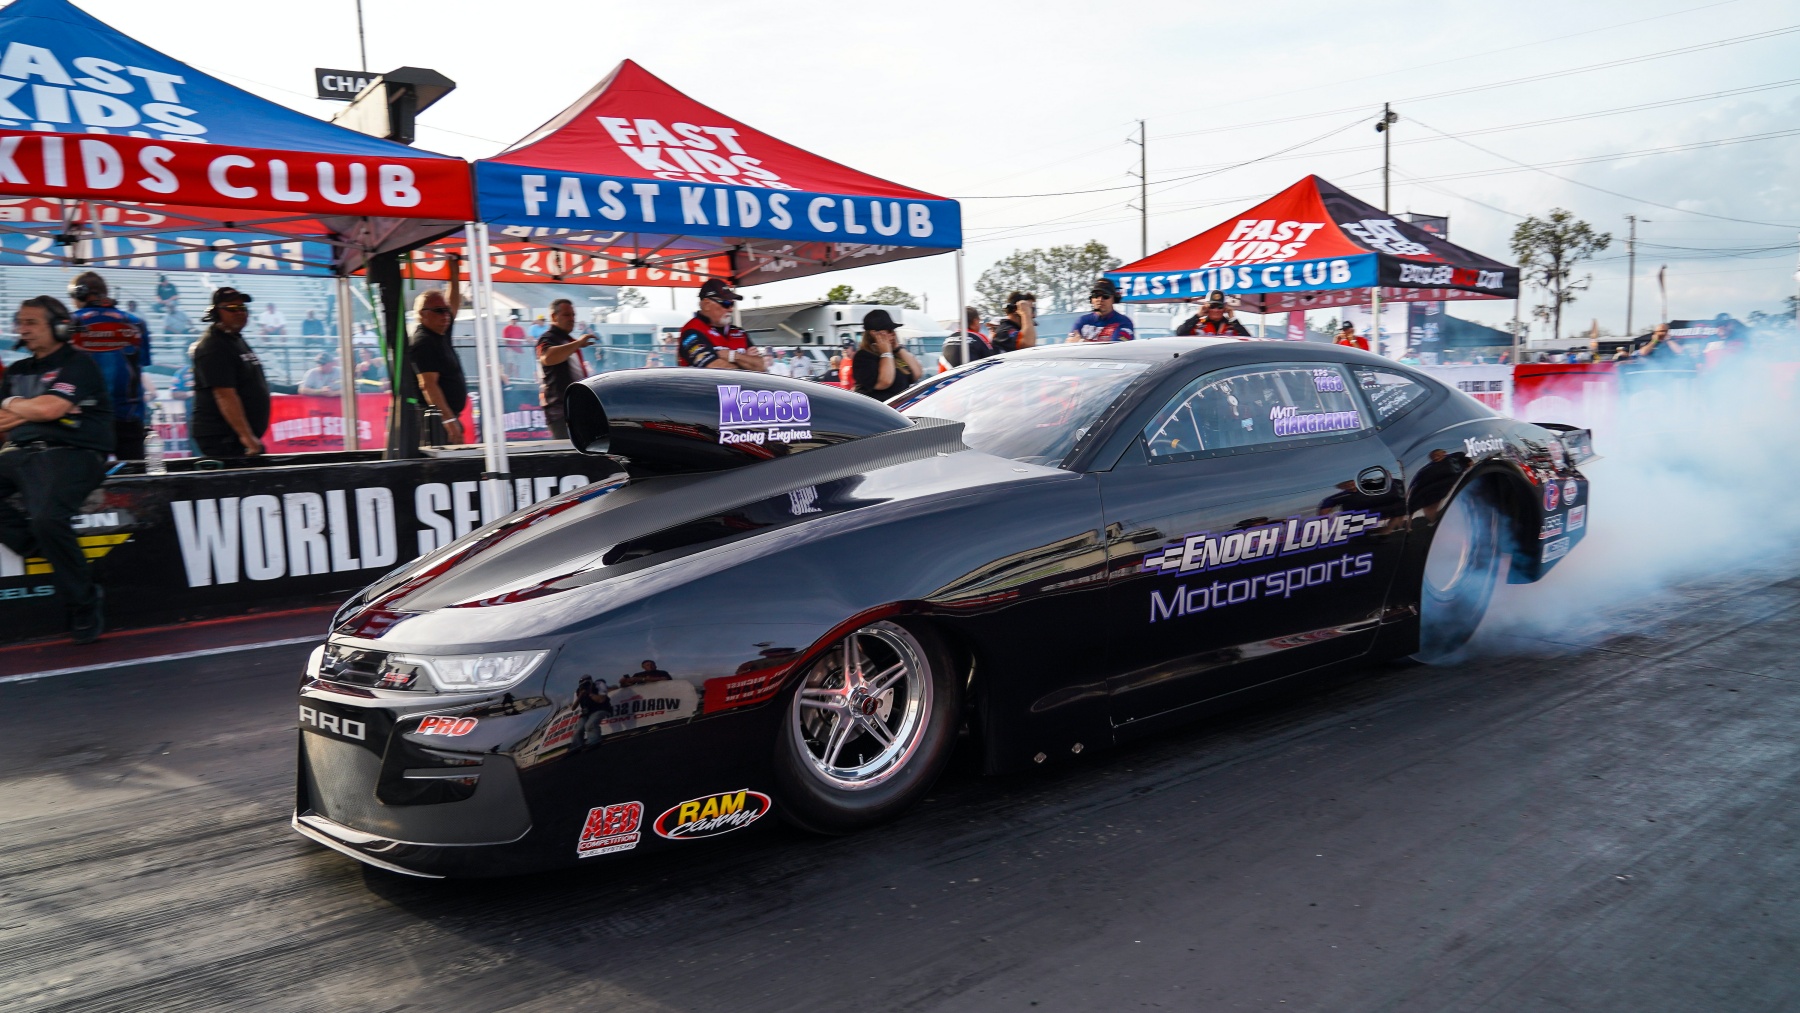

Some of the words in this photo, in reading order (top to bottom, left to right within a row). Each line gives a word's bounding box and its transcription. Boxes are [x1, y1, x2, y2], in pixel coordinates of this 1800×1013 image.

[0, 41, 186, 103] AST
[322, 74, 374, 93] CHA
[596, 116, 748, 154] FAST
[207, 154, 421, 208] CLUB
[618, 145, 782, 181] KIDS
[521, 174, 660, 222] FAST
[679, 186, 793, 230] KIDS
[808, 197, 935, 238] CLUB
[1227, 219, 1326, 241] FAST
[1209, 241, 1307, 261] KIDS
[1119, 273, 1182, 297] FAST
[1190, 267, 1253, 293] KIDS
[1261, 259, 1351, 288] CLUB
[717, 385, 811, 425] Kaase
[1270, 406, 1298, 421] MATT
[719, 430, 765, 444] Racing
[768, 427, 812, 443] Engines
[1274, 411, 1360, 436] GIANGRANDE
[171, 487, 398, 587] WORLD
[1180, 526, 1279, 572] ENOCH
[1282, 513, 1352, 553] LOVE
[1150, 552, 1373, 623] Motorsports
[299, 705, 366, 741] ARO
[415, 715, 479, 737] PRO
[582, 803, 642, 840] AED
[667, 808, 759, 838] Clutches
[677, 790, 748, 826] RAM
[579, 833, 638, 850] COMPETITION
